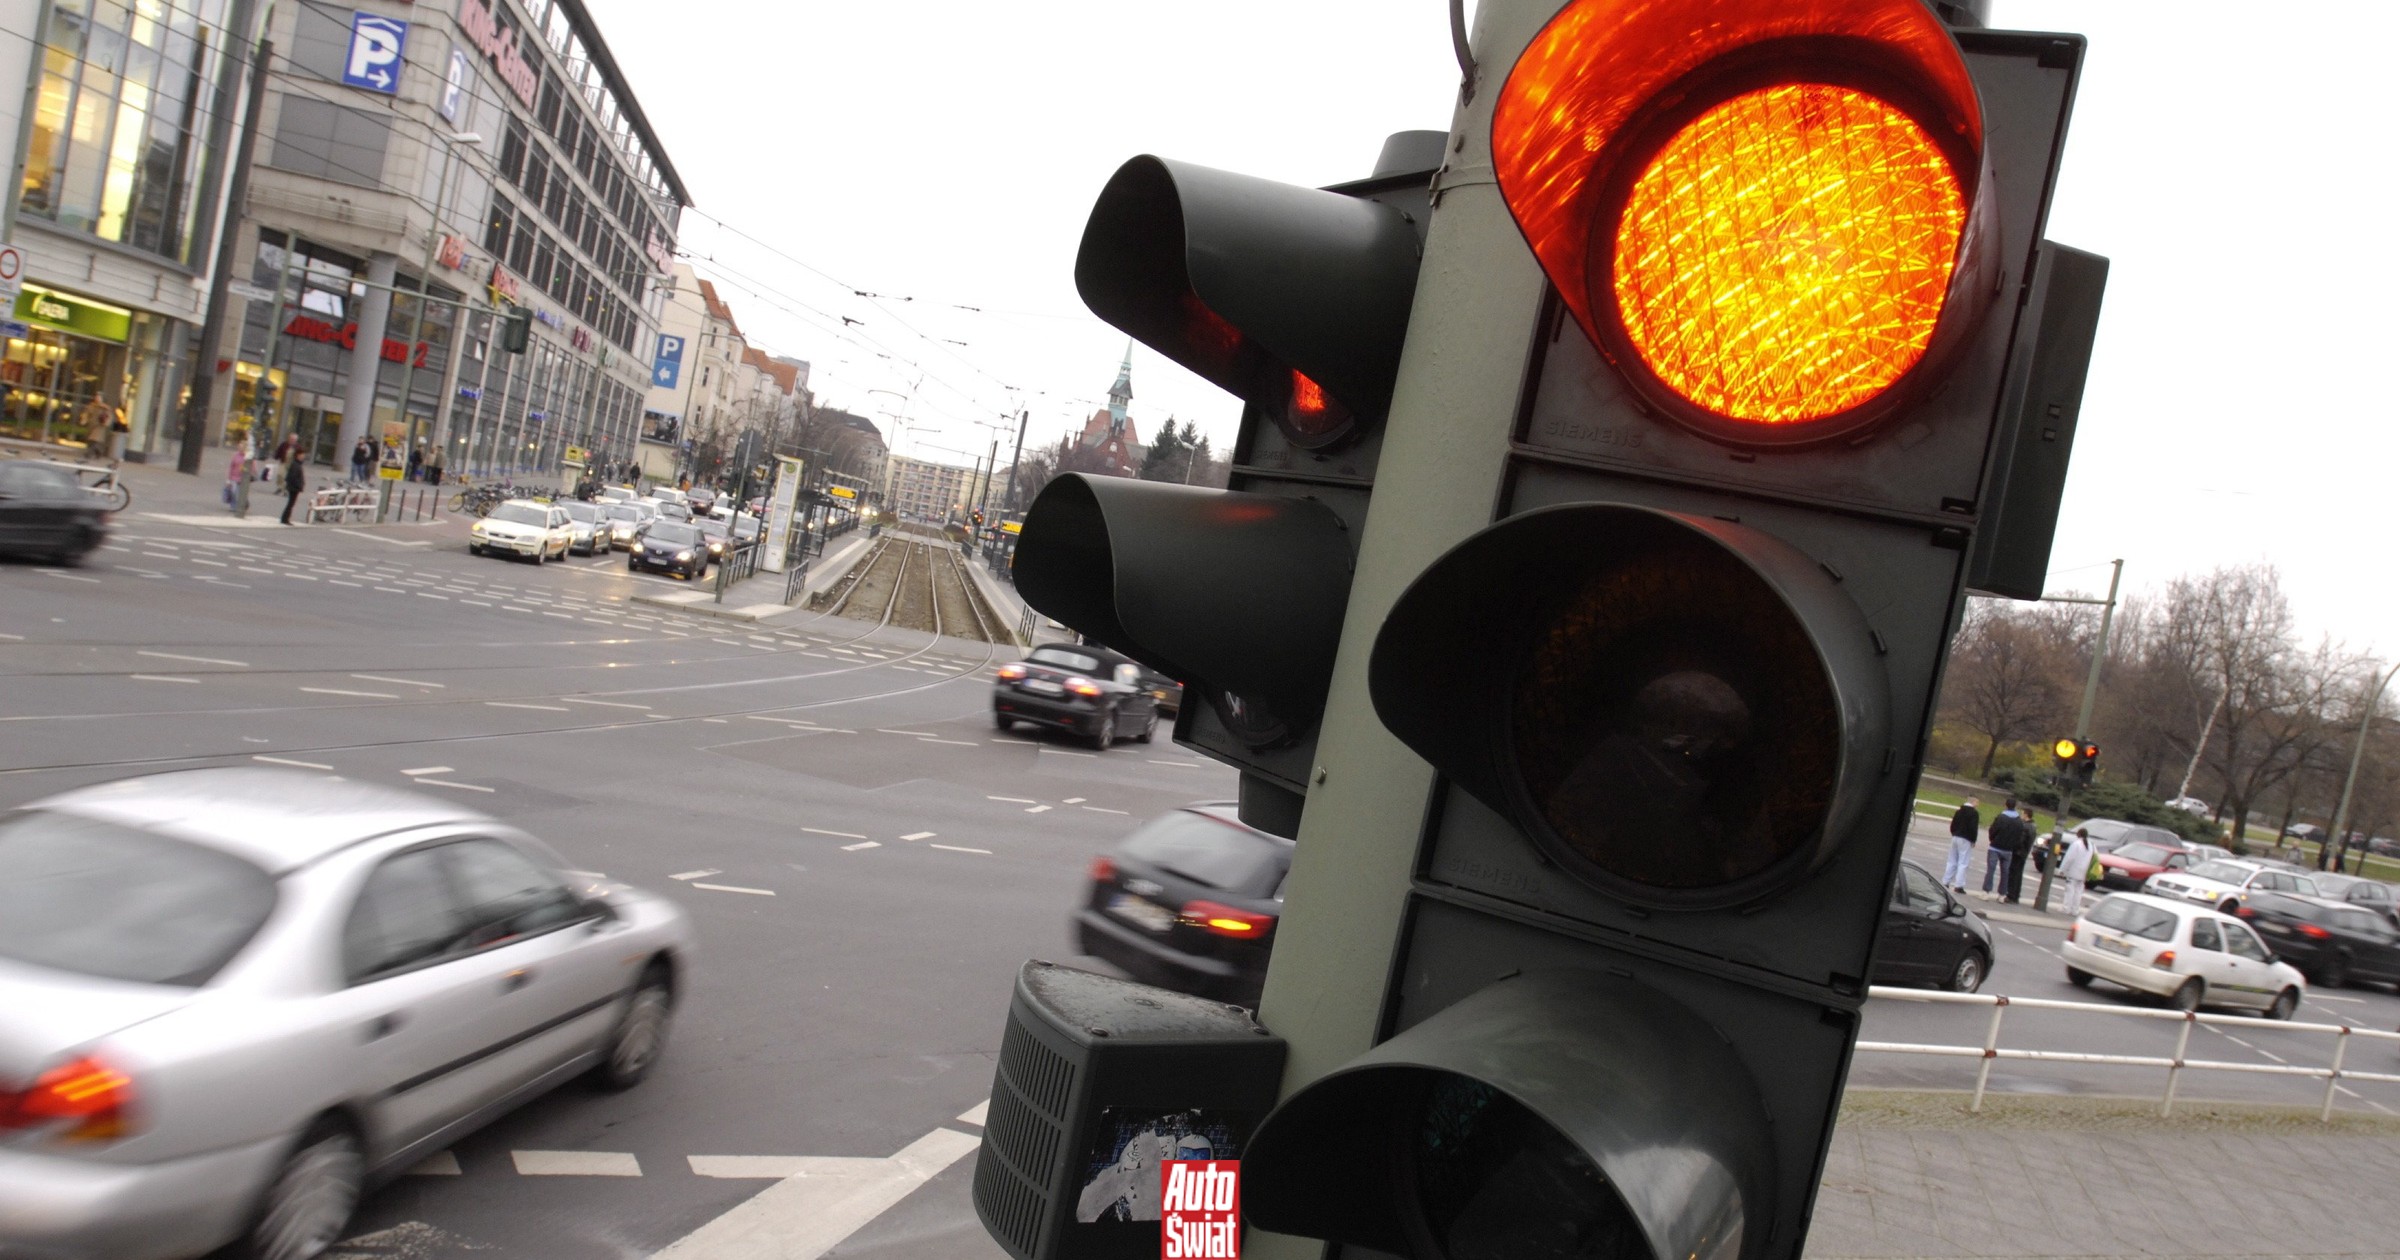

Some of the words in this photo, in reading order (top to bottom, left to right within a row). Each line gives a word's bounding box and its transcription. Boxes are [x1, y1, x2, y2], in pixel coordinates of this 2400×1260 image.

[349, 25, 399, 78] P
[413, 341, 429, 368] 2
[661, 337, 679, 357] P
[1545, 421, 1642, 449] SIEMENS
[1449, 857, 1541, 893] SIEMENS
